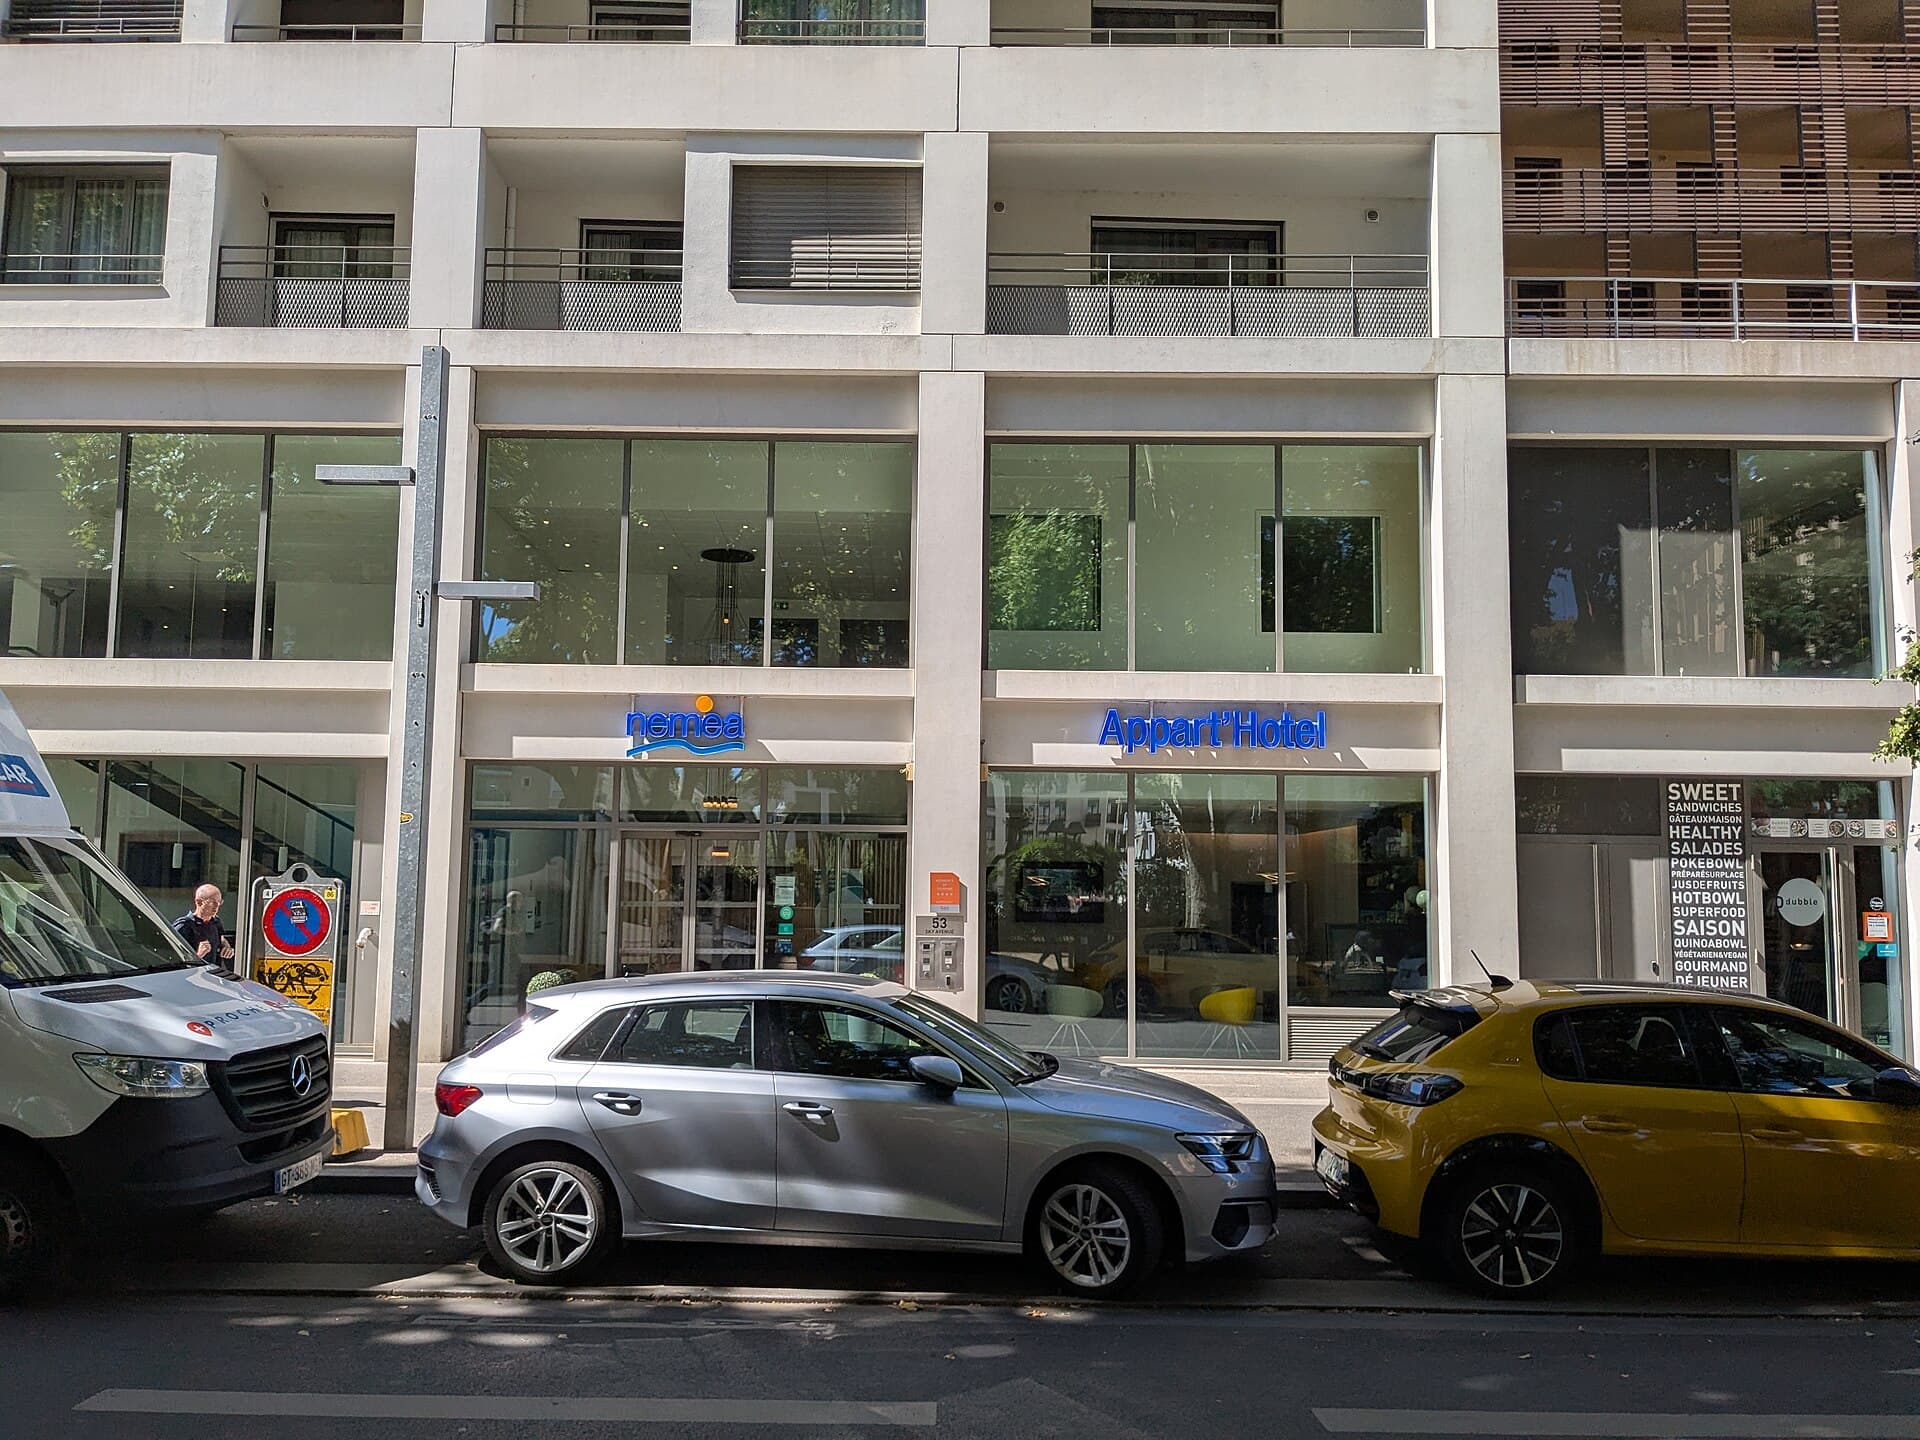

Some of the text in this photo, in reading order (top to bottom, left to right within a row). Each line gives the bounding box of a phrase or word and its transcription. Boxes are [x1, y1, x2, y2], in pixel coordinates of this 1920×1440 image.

[1668, 783, 1741, 801] SWEET
[1668, 802, 1742, 813] SANDWICHES
[1669, 825, 1742, 839] HEALTHY
[1671, 841, 1743, 855] SALADES
[1671, 858, 1744, 869] POKEBOWL
[1672, 880, 1745, 890] JUSDEFRUITS
[1672, 891, 1745, 905] HOTBOWL
[1785, 897, 1818, 906] dubble
[1673, 907, 1746, 918] SUPERFOOD
[932, 917, 948, 929] 53
[1673, 919, 1745, 937] SAISON
[1674, 938, 1747, 949] QUINOABOWL
[1675, 960, 1748, 973] GOURMAND
